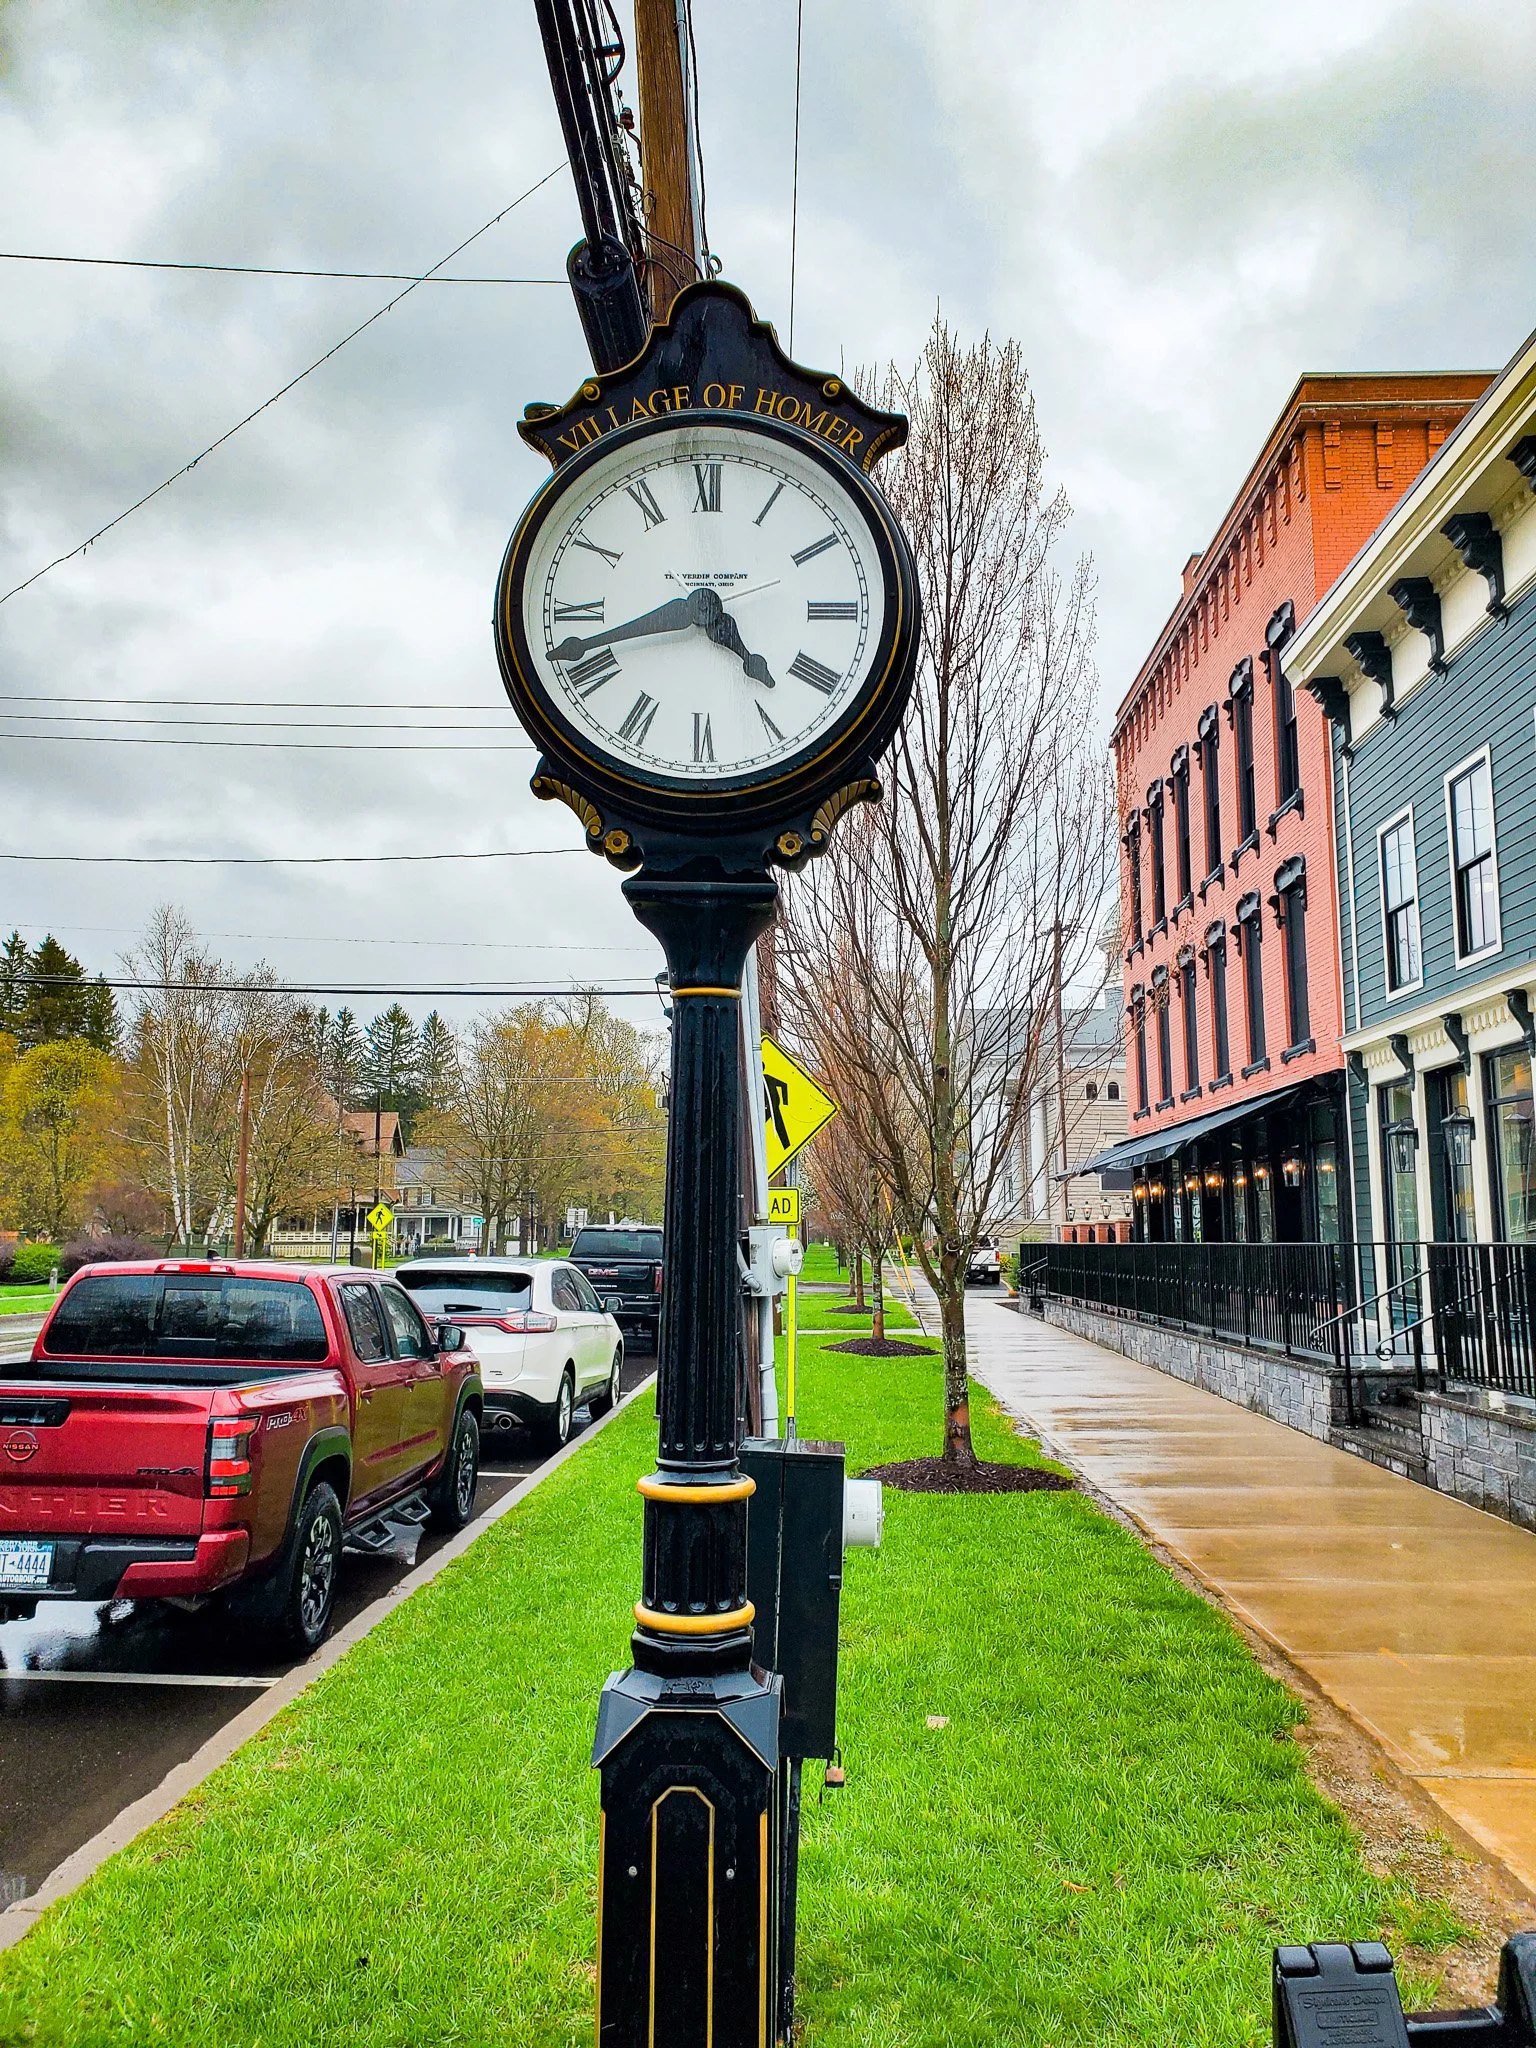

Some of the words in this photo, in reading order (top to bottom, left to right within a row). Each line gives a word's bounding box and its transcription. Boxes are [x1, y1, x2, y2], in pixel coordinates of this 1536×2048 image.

[557, 385, 693, 452] VILLAGE
[703, 383, 746, 409] OF
[754, 387, 865, 456] HOMER
[622, 477, 668, 532] XI
[692, 463, 724, 513] XII
[771, 1197, 791, 1214] AD
